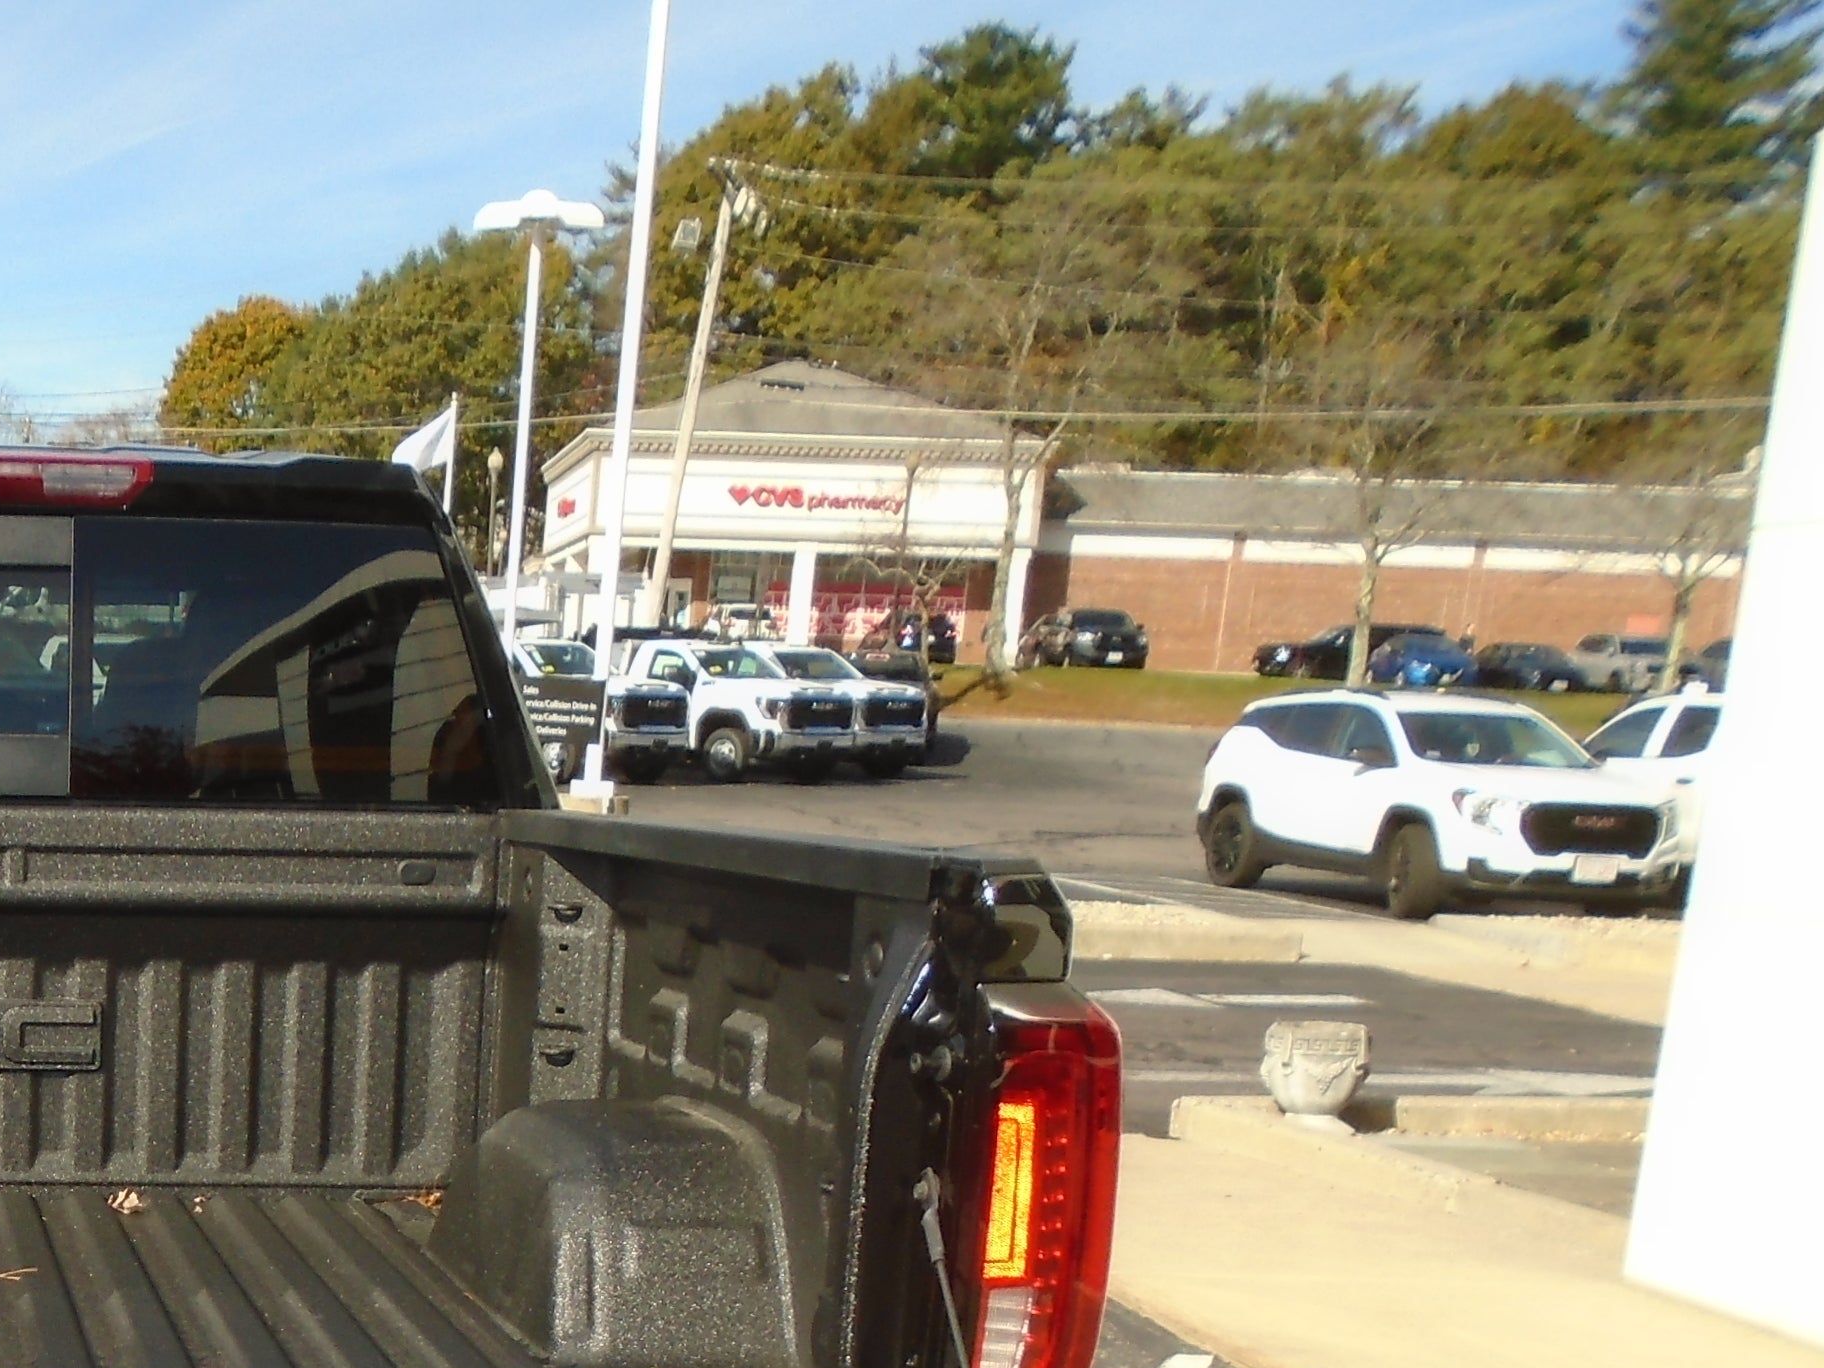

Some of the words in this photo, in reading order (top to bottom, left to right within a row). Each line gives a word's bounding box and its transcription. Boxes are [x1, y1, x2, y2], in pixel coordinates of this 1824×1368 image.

[751, 486, 804, 508] CVS
[807, 492, 905, 516] pharmacy
[522, 684, 540, 695] Sales
[525, 699, 572, 709] ervice/Collision
[571, 714, 596, 727] Parking
